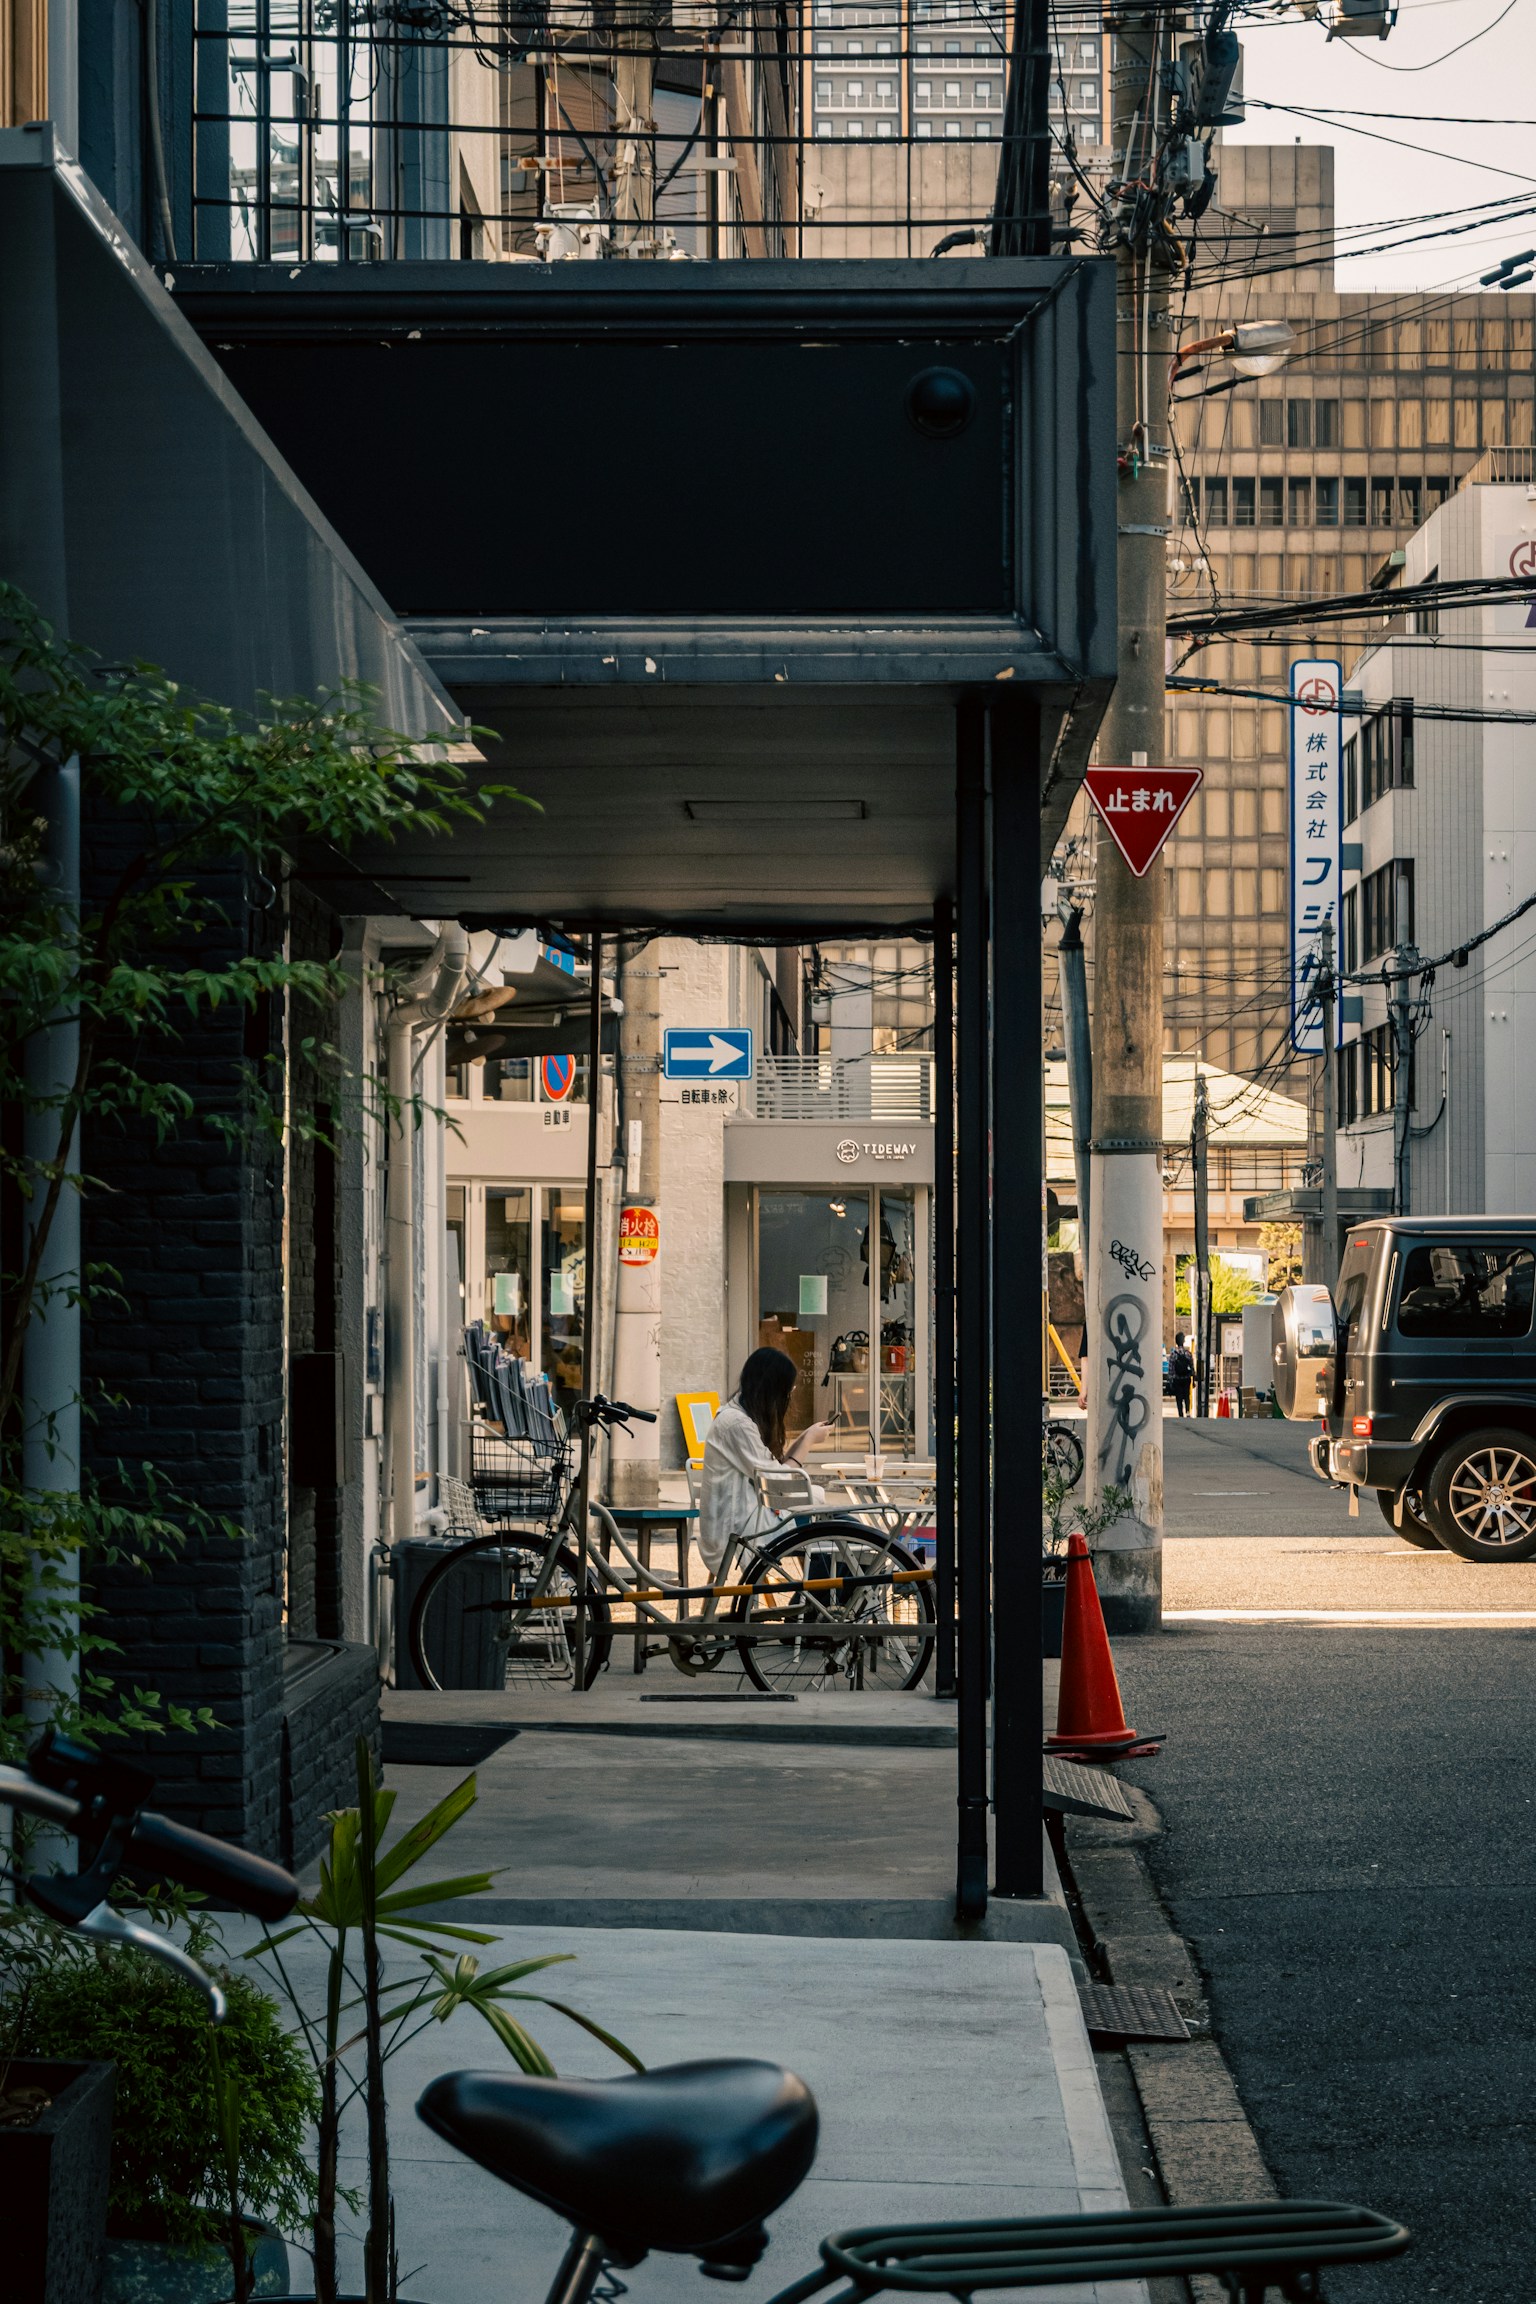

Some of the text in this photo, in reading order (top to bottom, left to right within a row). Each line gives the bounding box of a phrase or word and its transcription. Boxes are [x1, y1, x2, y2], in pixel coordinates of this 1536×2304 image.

[1105, 787, 1177, 812] 止まれ
[682, 1089, 735, 1104] 自転車を除く
[544, 1110, 570, 1125] 自動車
[863, 1144, 916, 1154] TIDEWAY
[620, 1217, 656, 1237] 消火栓
